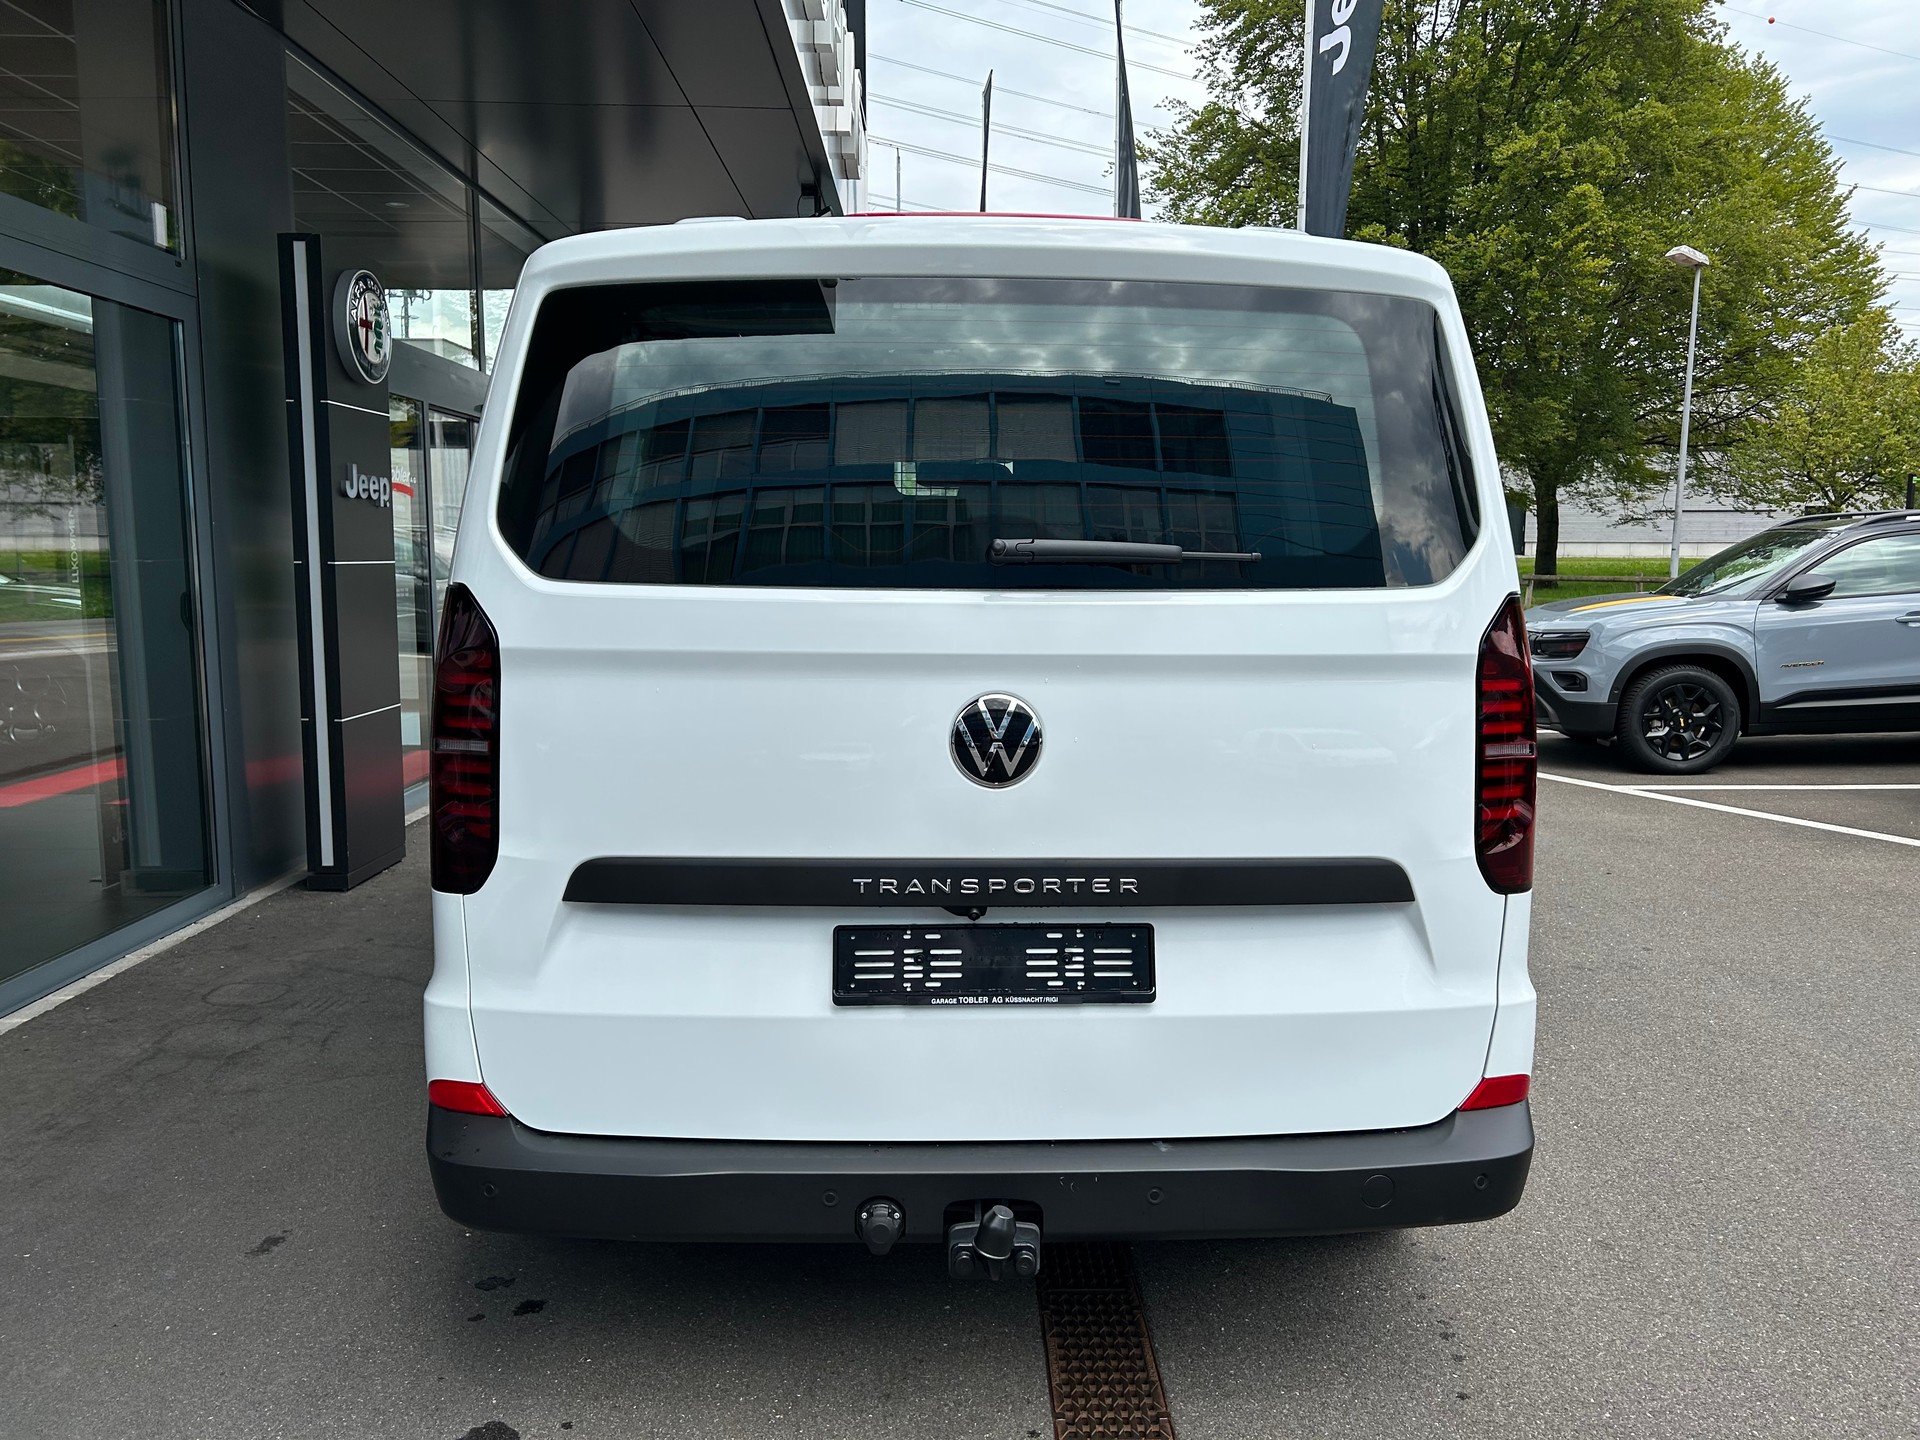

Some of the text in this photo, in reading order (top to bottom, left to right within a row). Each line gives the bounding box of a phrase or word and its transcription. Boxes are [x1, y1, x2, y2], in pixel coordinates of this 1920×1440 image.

[350, 280, 367, 322] ALFA
[391, 466, 411, 483] obler
[67, 507, 80, 583] LLKOMMEN
[852, 878, 1139, 895] TRANSPORTER
[958, 996, 989, 1004] TOBLER
[991, 996, 1003, 1004] AG
